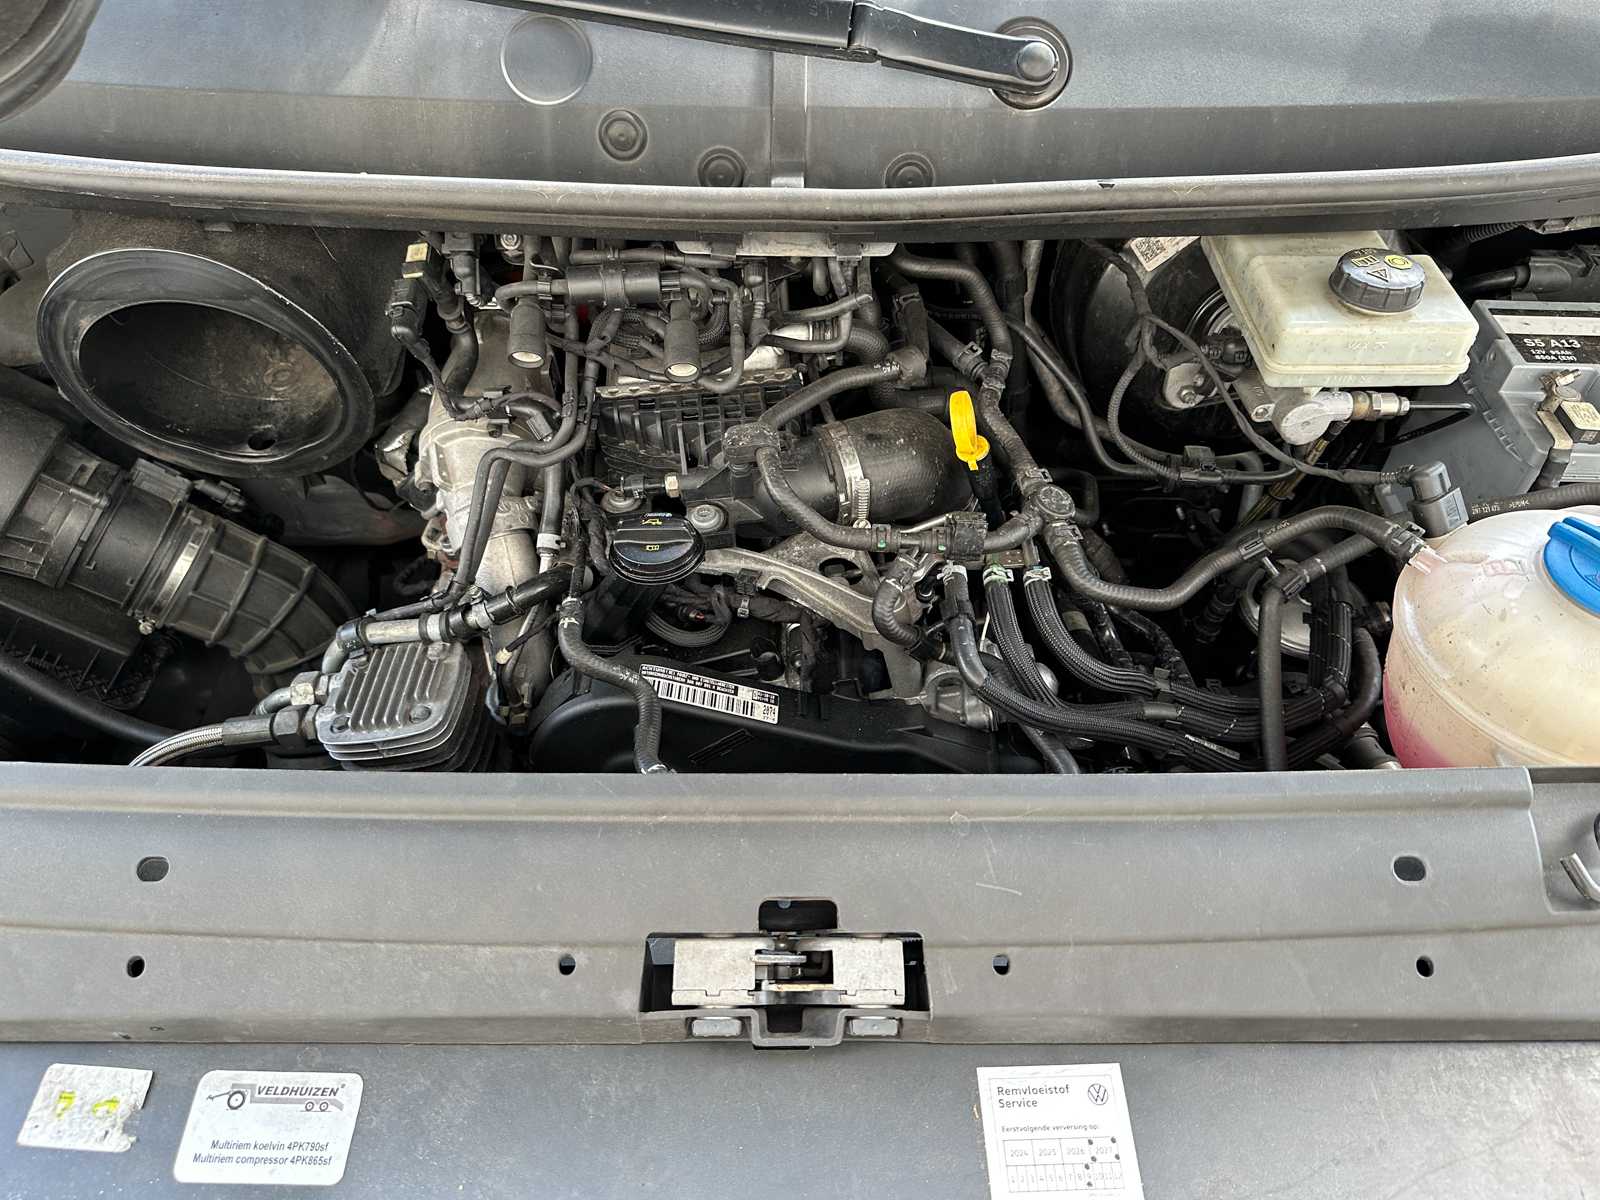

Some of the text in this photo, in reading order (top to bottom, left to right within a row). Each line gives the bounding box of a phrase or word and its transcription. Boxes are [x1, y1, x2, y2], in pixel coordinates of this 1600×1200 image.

[1523, 338, 1581, 348] S5 A13
[256, 1085, 341, 1098] VELDHUIZEN
[997, 1084, 1070, 1096] Remvloeistof
[998, 1098, 1038, 1108] Service
[210, 1140, 329, 1152] Multiriem koelvin 4PK790sf
[193, 1153, 332, 1167] Multiriem compressor 4PK865sf
